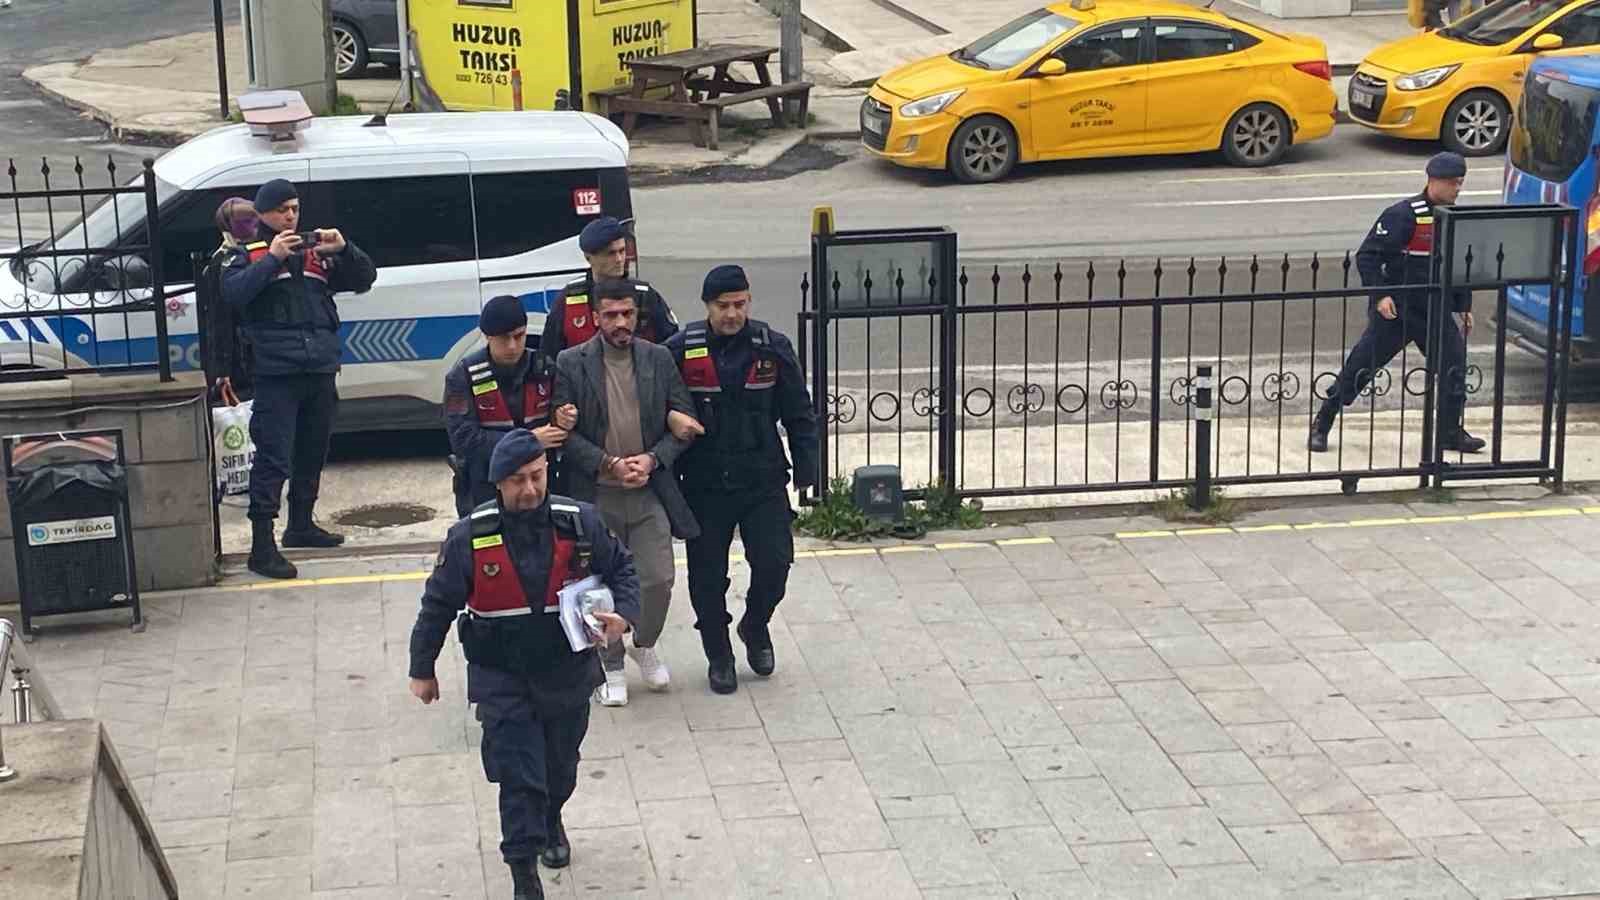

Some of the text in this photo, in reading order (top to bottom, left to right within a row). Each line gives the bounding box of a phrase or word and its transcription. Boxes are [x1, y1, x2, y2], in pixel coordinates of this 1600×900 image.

[452, 23, 521, 47] HUZUR
[612, 19, 662, 47] HUZUR
[460, 48, 517, 71] TAKSİ
[475, 72, 493, 85] 726
[577, 191, 598, 205] 112
